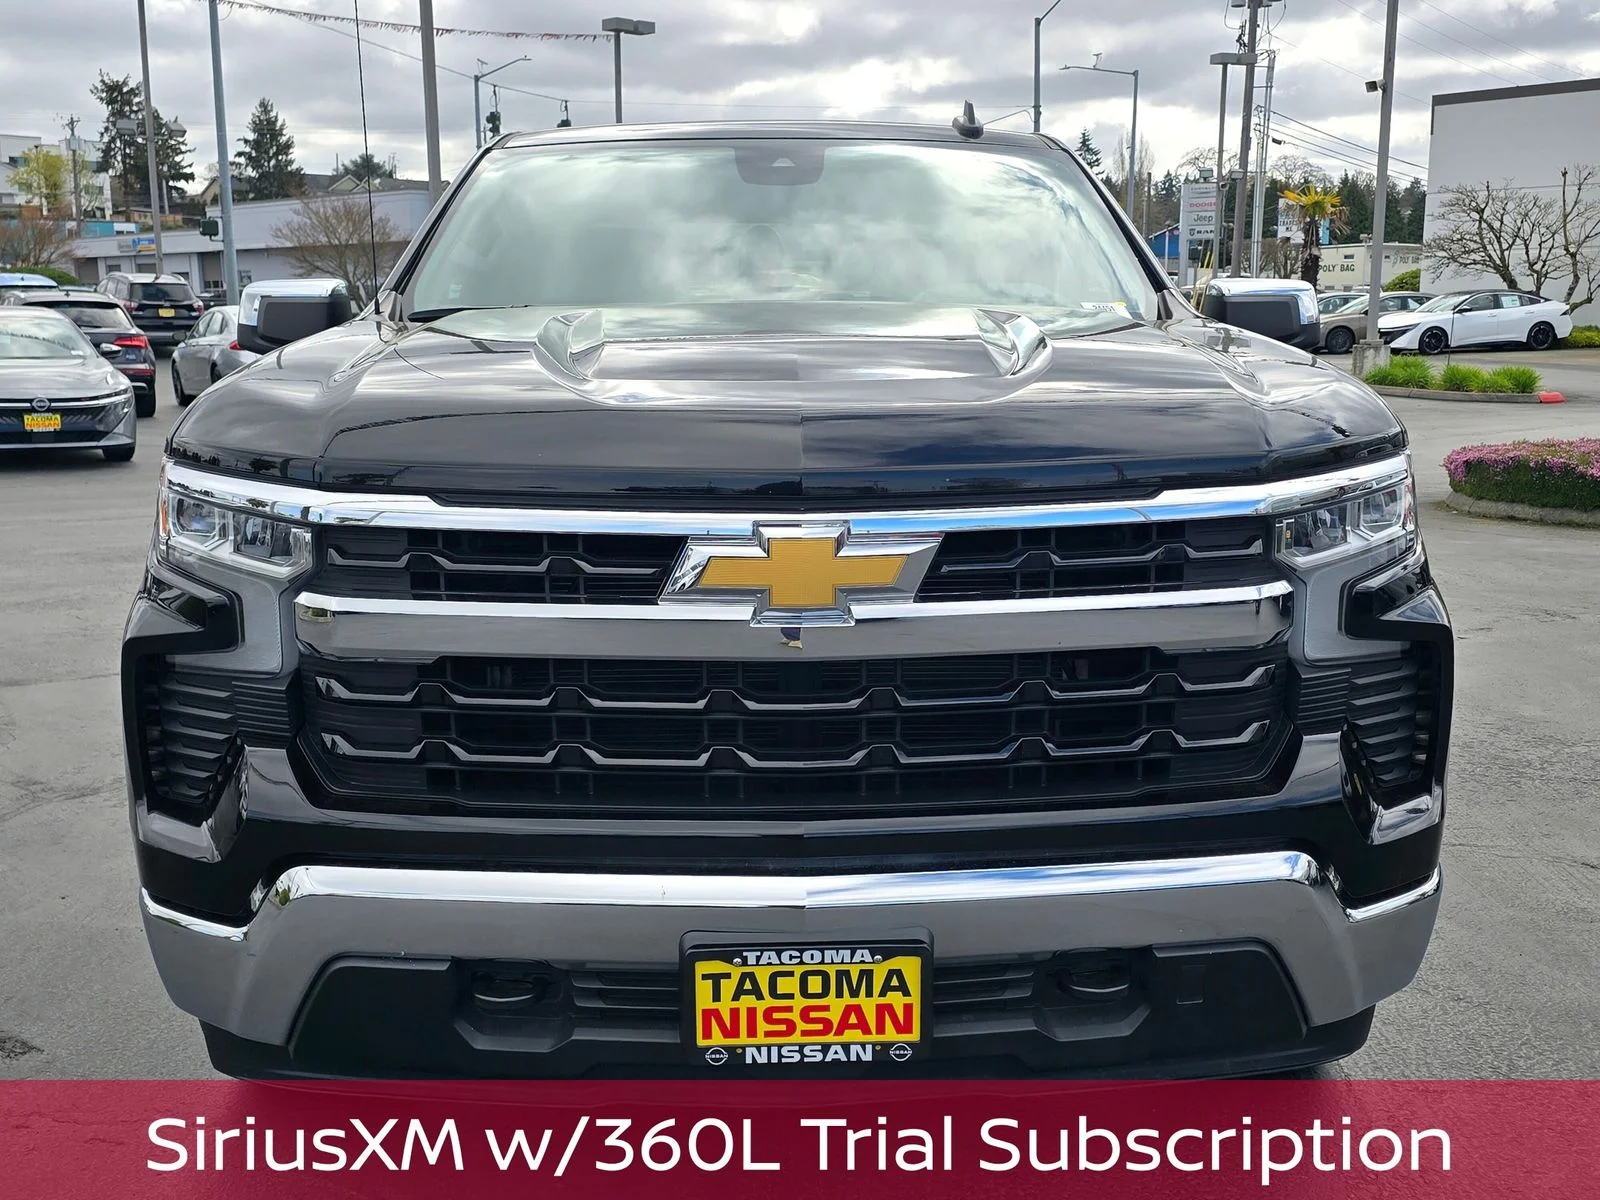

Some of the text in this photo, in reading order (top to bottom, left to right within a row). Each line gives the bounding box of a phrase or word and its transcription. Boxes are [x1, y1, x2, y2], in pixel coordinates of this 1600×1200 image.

[1193, 214, 1213, 224] Jeep
[1318, 263, 1355, 273] POLY BAG
[743, 949, 873, 964] TACOMA
[701, 968, 912, 1003] TACOMA
[701, 1002, 914, 1040] NISSAN
[745, 1045, 873, 1064] NISSAN
